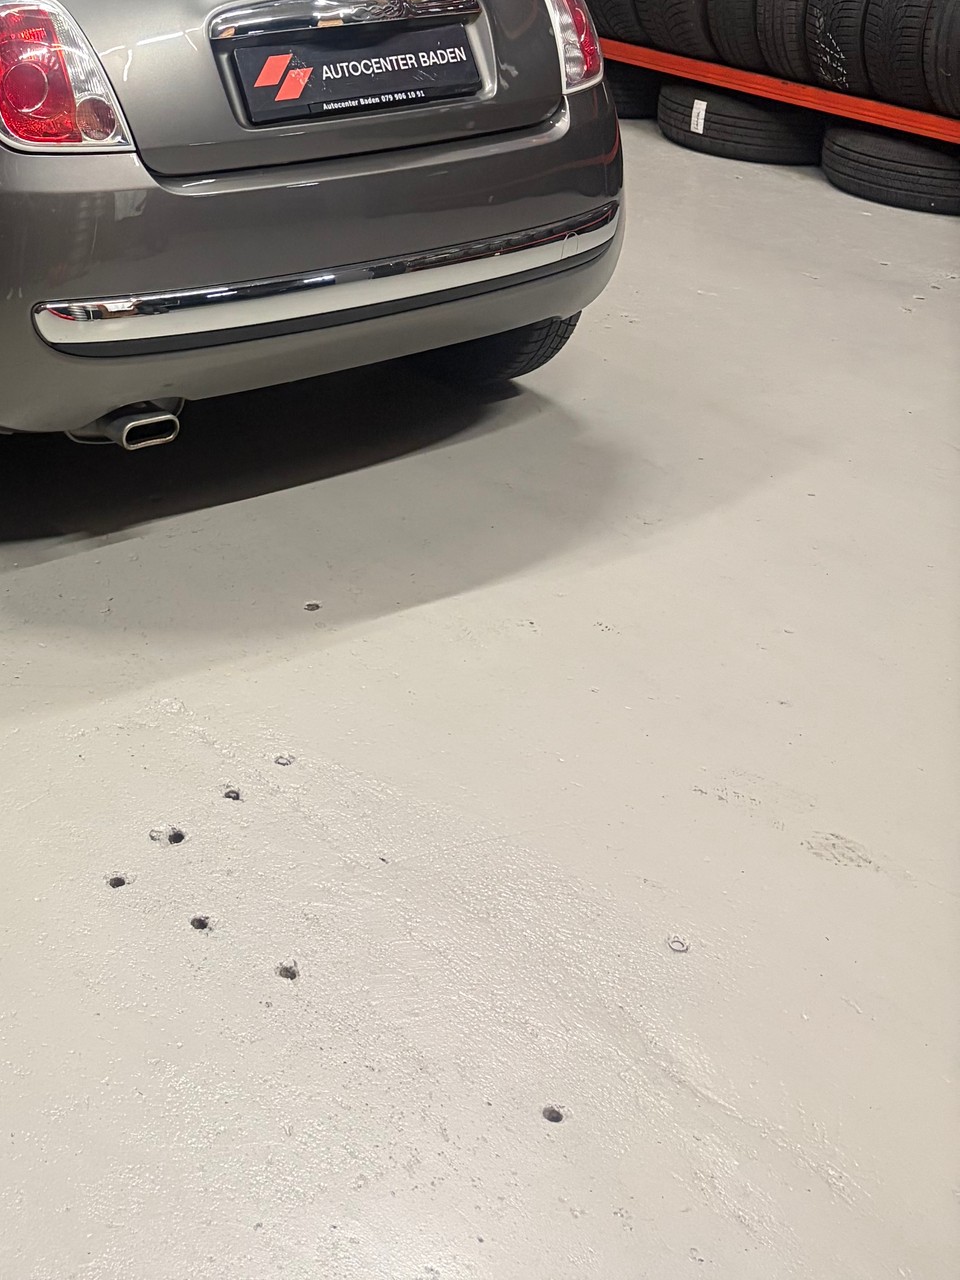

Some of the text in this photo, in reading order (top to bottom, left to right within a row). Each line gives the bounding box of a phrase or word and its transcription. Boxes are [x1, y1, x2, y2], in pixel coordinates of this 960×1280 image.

[322, 46, 467, 81] AUTOCENTER BADEN
[323, 99, 359, 111] Autocenter
[360, 96, 380, 105] Baden
[381, 94, 394, 103] 079
[394, 92, 407, 101] 906
[408, 91, 416, 99] 10
